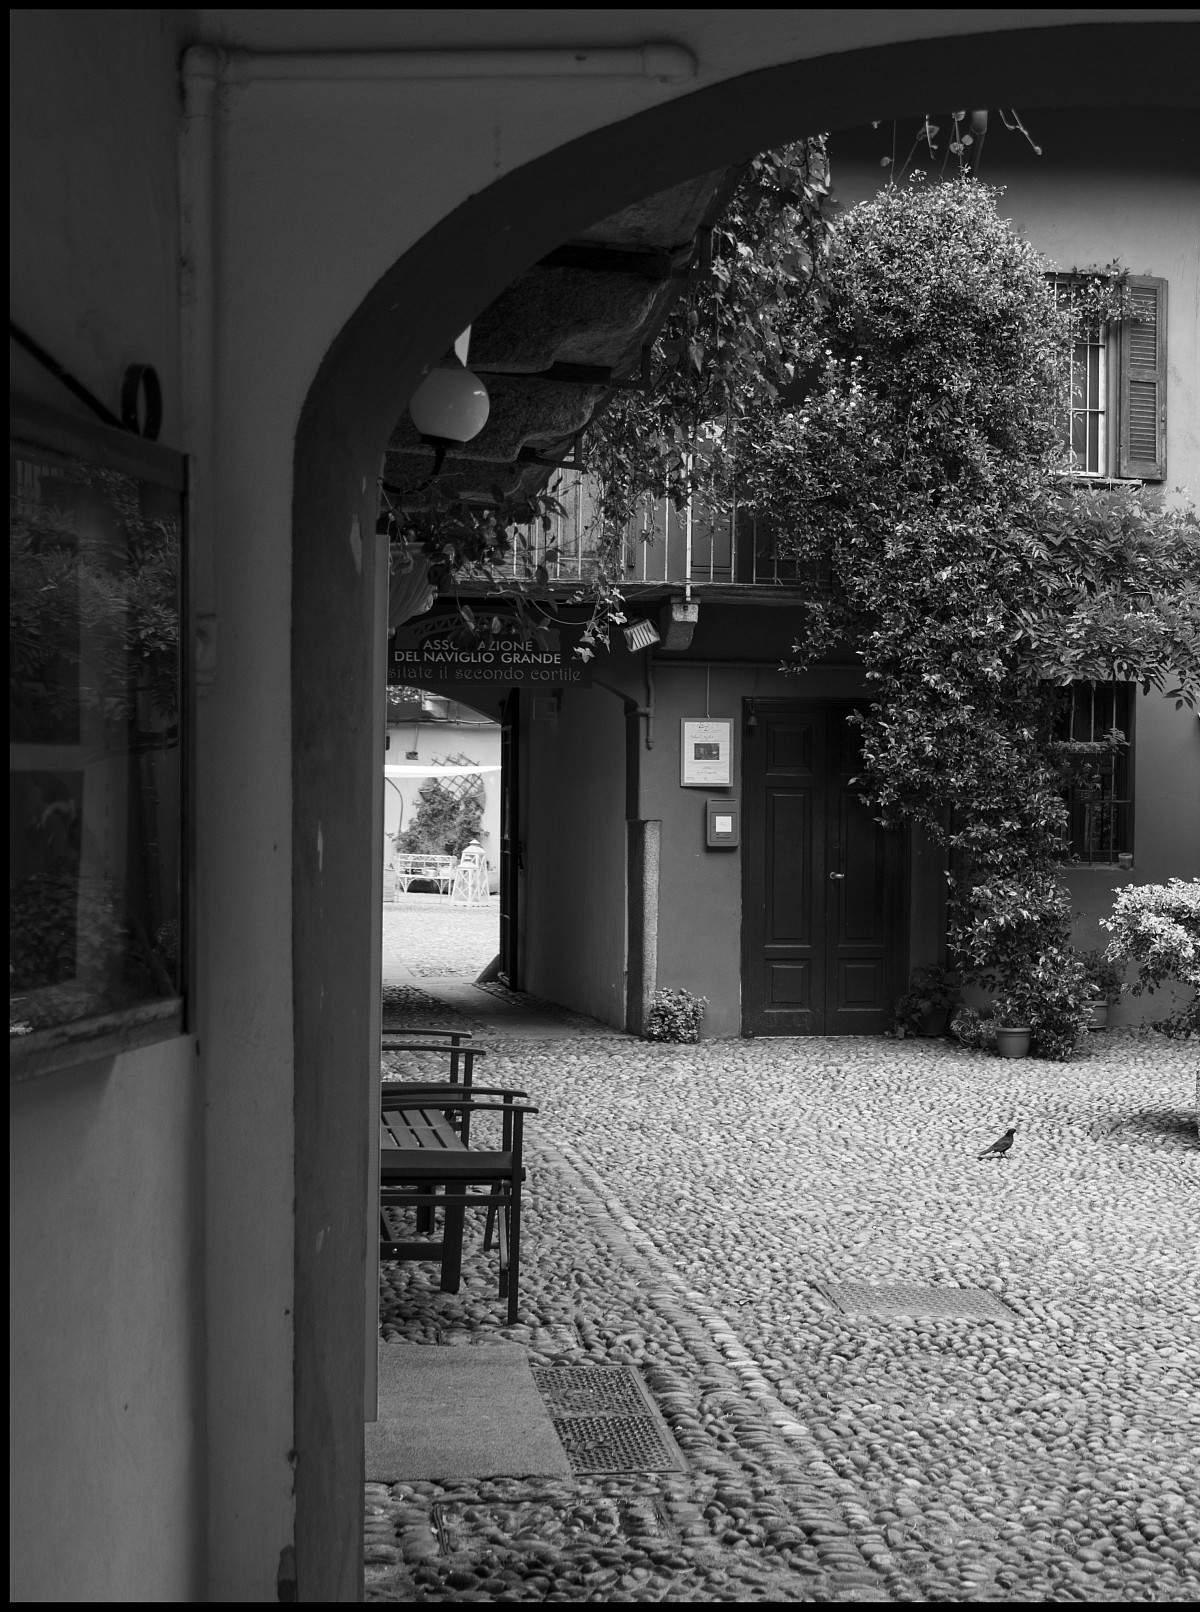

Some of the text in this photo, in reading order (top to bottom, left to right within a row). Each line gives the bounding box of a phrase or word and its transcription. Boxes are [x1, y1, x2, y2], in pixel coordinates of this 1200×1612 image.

[423, 639, 533, 652] ASSOAZIONE
[394, 651, 562, 665] DEL NAVIGLIO GRANDE
[388, 666, 582, 683] sitate il secondo cortile
